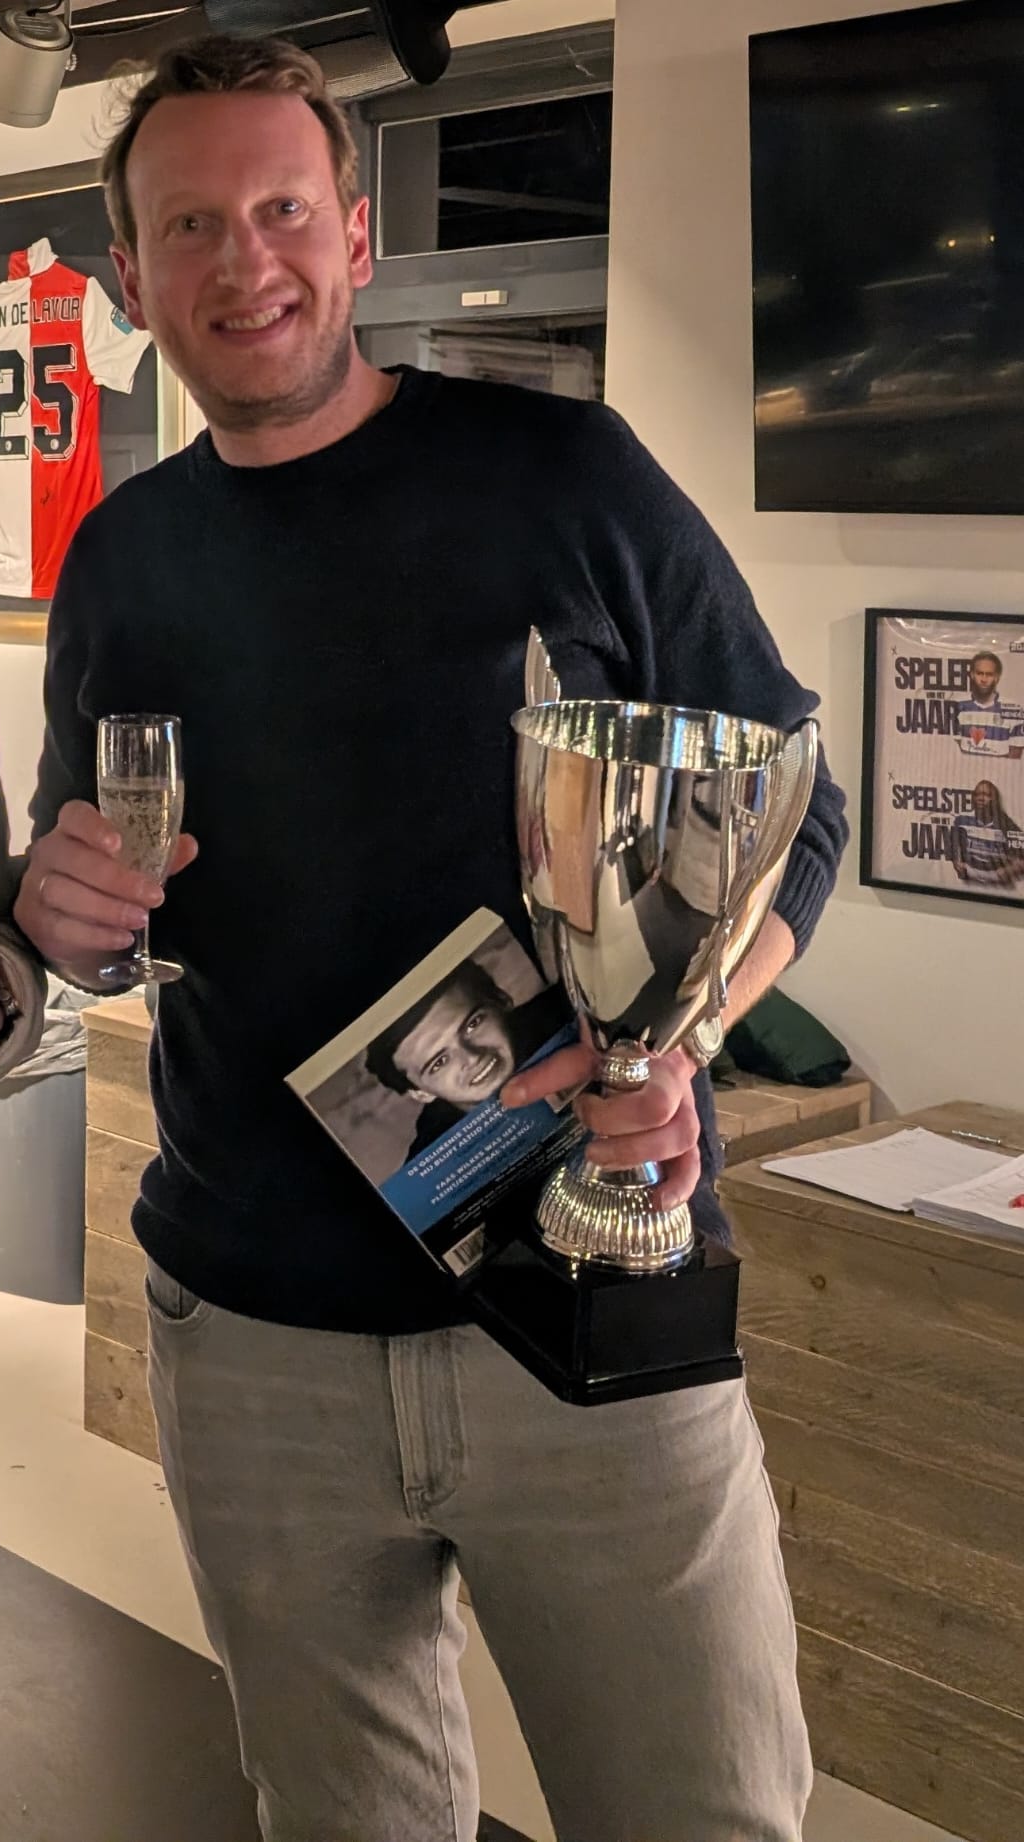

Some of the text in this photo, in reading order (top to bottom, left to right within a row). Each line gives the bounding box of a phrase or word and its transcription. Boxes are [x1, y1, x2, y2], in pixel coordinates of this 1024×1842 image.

[11, 302, 29, 326] DE
[895, 657, 974, 691] SPELER
[407, 1164, 418, 1177] DE
